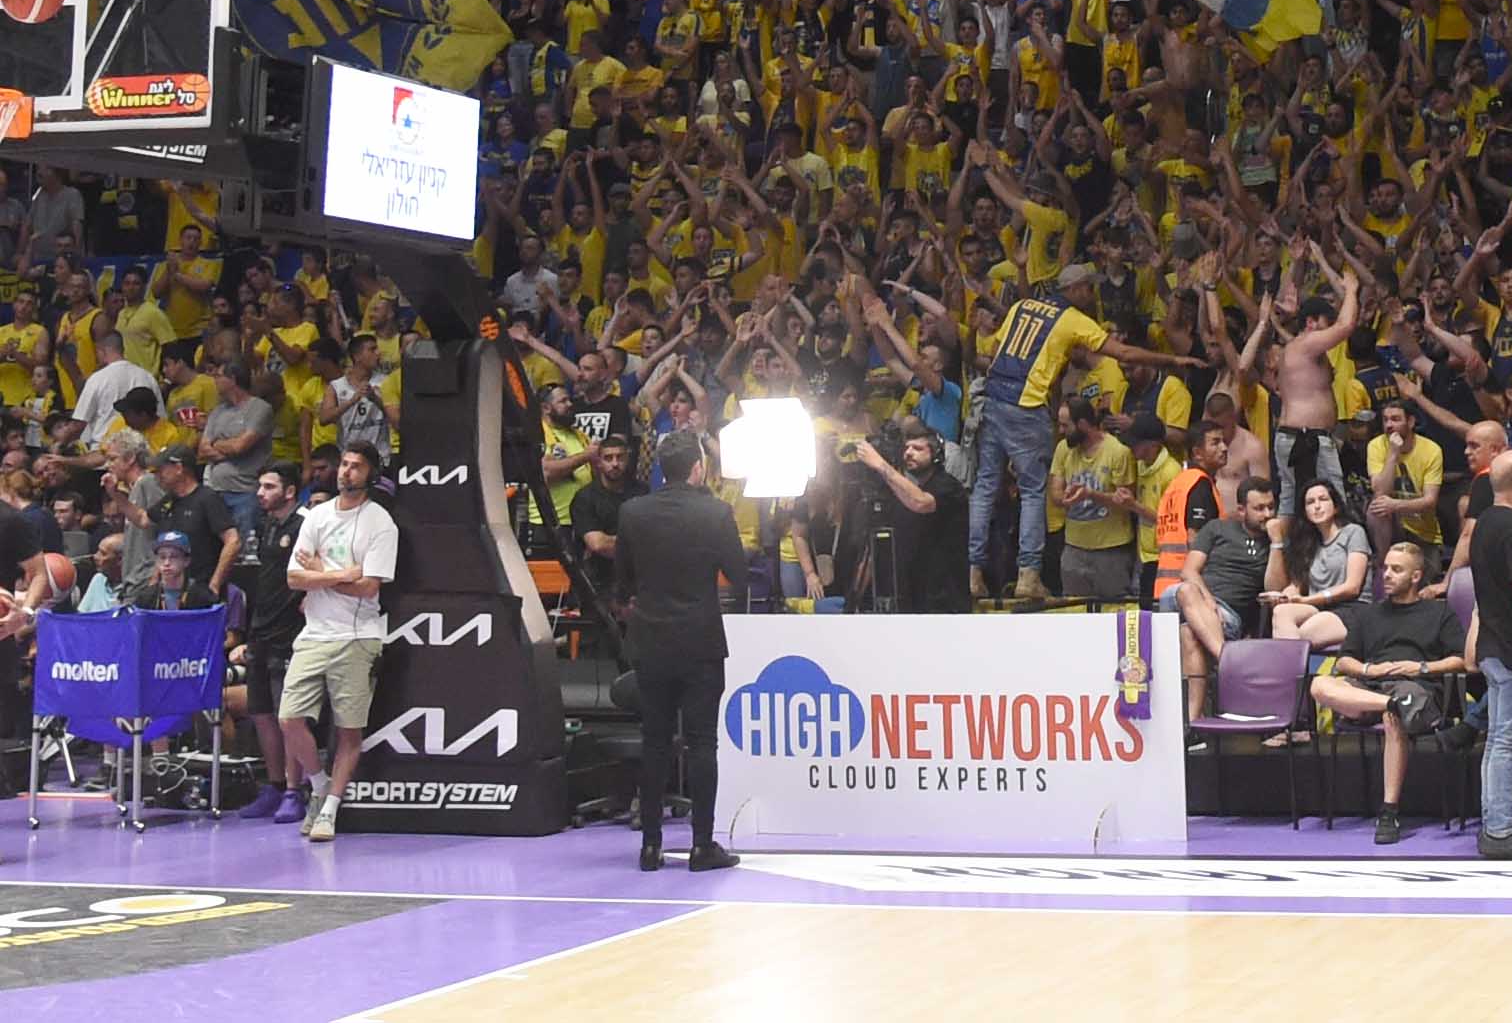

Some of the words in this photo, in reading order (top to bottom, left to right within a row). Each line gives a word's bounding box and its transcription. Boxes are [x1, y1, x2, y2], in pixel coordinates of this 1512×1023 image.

[101, 87, 176, 108] Winner
[177, 89, 196, 105] סל
[361, 145, 416, 184] עזריאלי
[418, 164, 447, 197] קניון
[385, 187, 420, 220] חולון
[1022, 298, 1058, 319] GATE
[1005, 313, 1044, 361] 11
[357, 402, 366, 416] 6
[398, 464, 468, 485] KIA
[381, 612, 493, 646] KIA
[1128, 623, 1137, 655] HOLON
[52, 660, 119, 682] molten
[154, 657, 209, 679] molten
[740, 692, 852, 756] HIGH
[871, 694, 1145, 762] NETWORKS
[809, 765, 897, 790] CLOUD
[918, 766, 1048, 792] EXPERTS
[343, 781, 519, 805] SPORTSYSTEM
